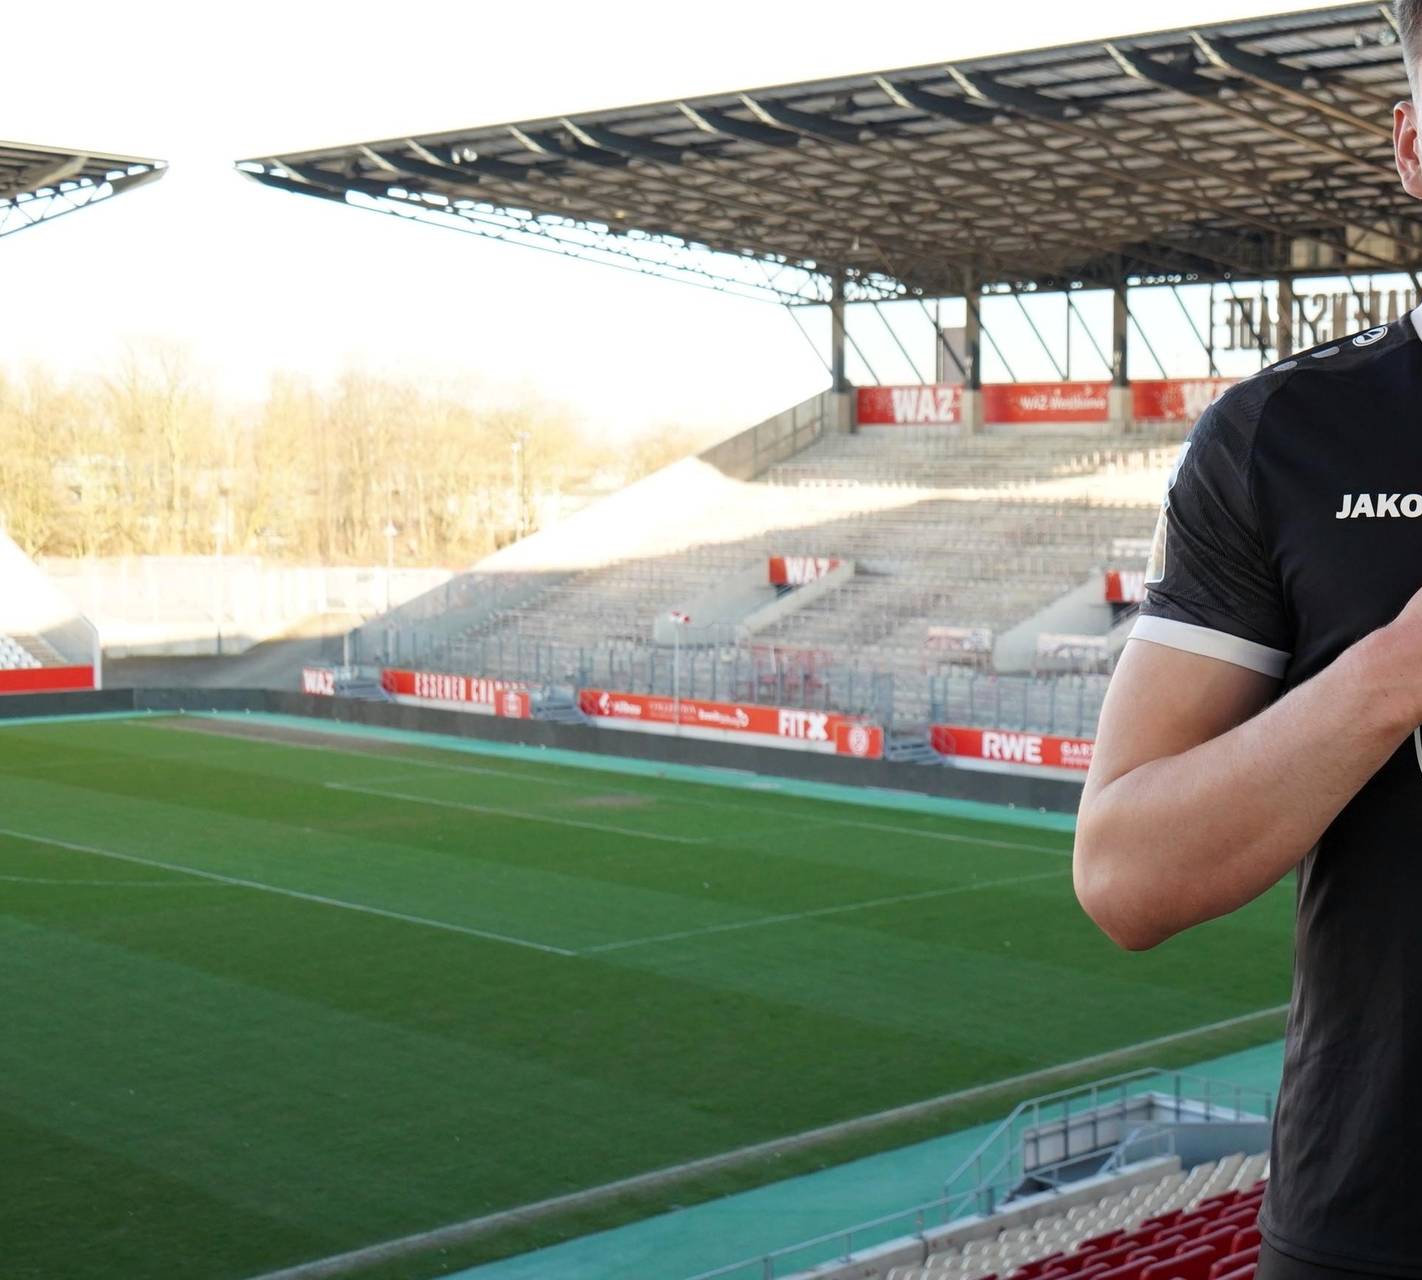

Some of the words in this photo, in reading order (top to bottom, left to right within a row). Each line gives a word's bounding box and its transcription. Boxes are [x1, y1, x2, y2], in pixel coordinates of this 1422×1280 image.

[893, 389, 955, 422] WAZ
[1019, 395, 1048, 411] WAZ
[303, 670, 335, 696] WAZ
[414, 672, 466, 701] ESSENER
[778, 709, 829, 741] FITX
[982, 731, 1043, 764] RWE
